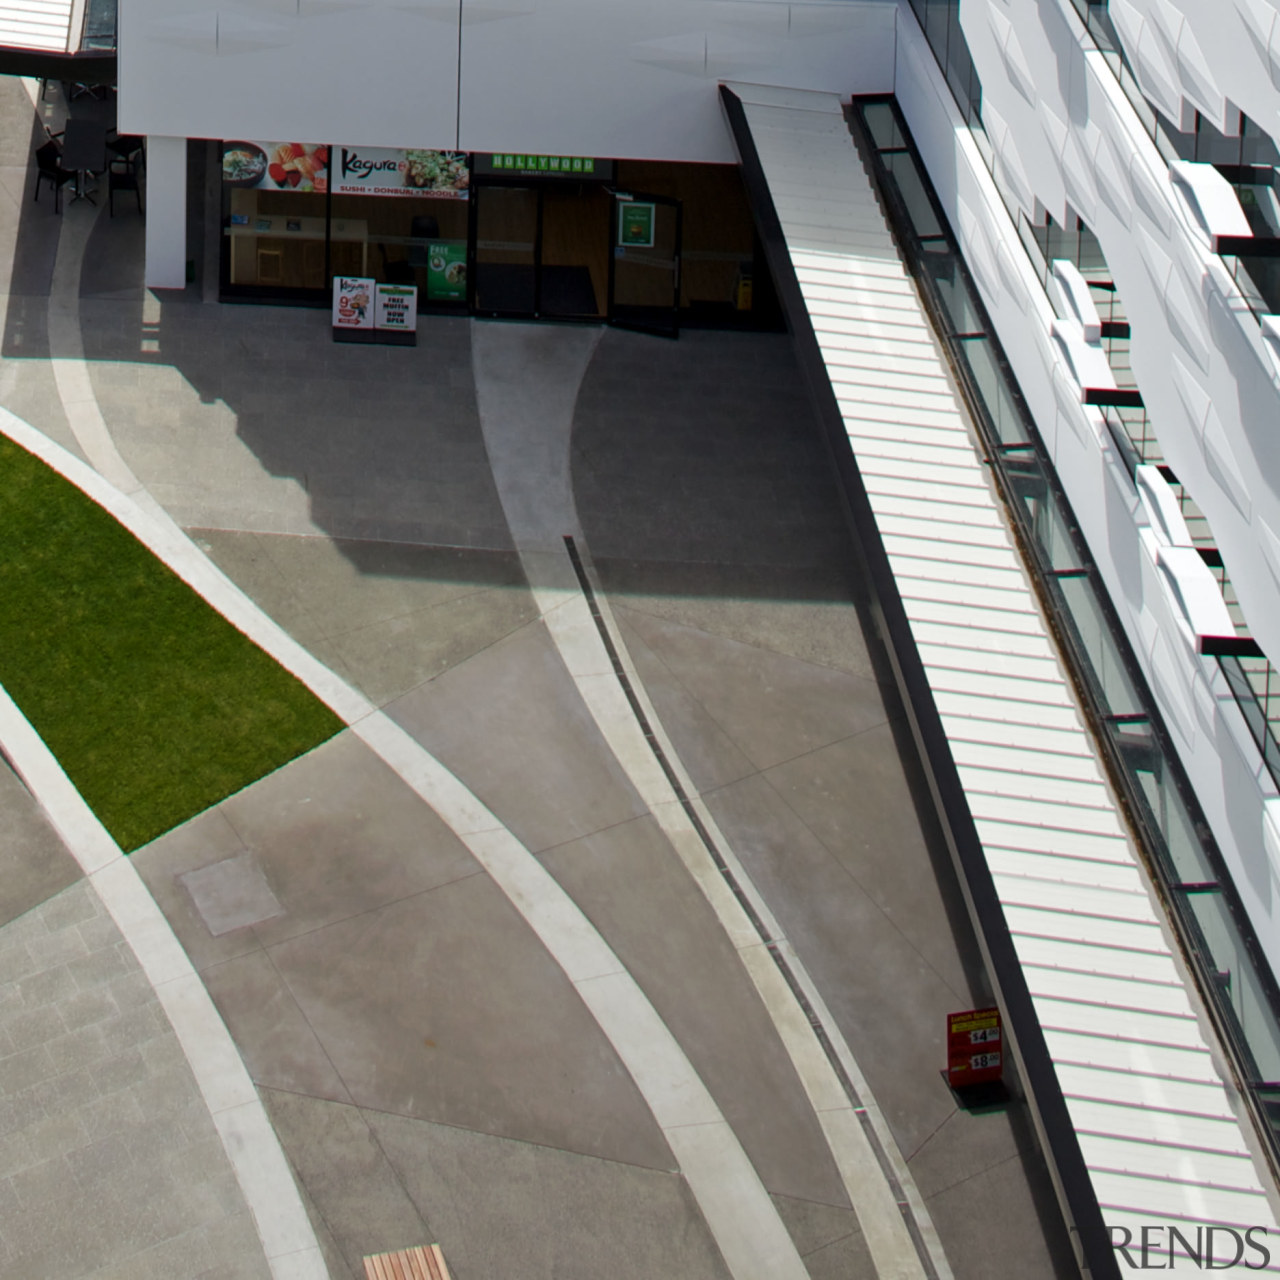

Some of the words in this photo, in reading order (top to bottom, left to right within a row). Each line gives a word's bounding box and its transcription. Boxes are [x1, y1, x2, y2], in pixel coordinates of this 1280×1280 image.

[341, 147, 397, 180] Kagura
[493, 153, 593, 171] HOLLYWOOD
[340, 185, 366, 193] SUSHI
[373, 187, 414, 196] DONBURI
[422, 190, 460, 198] NOODLE
